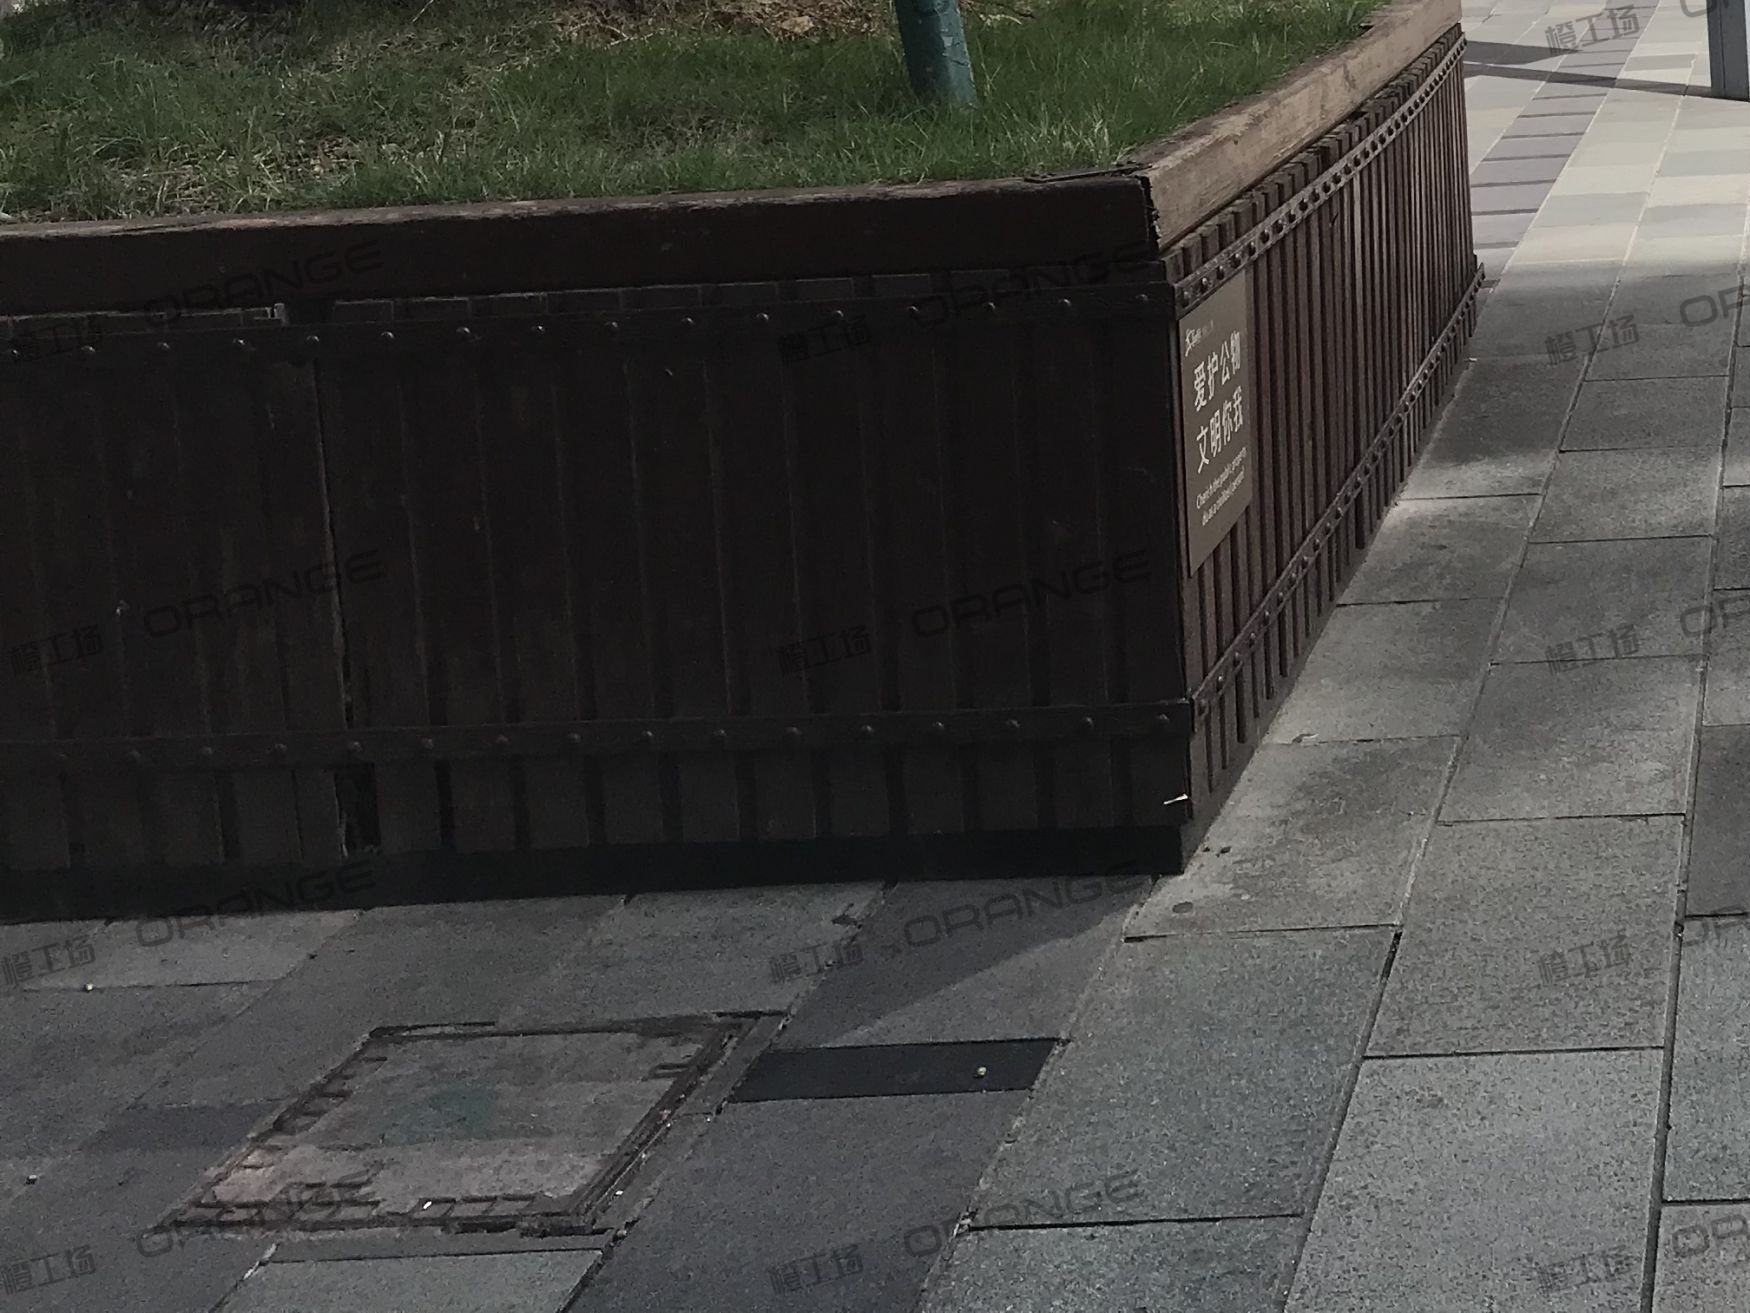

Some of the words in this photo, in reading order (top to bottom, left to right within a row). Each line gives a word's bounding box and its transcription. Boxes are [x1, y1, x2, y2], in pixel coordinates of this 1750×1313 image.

[1193, 331, 1241, 412] 爱护公物
[1196, 385, 1244, 474] 文明你我
